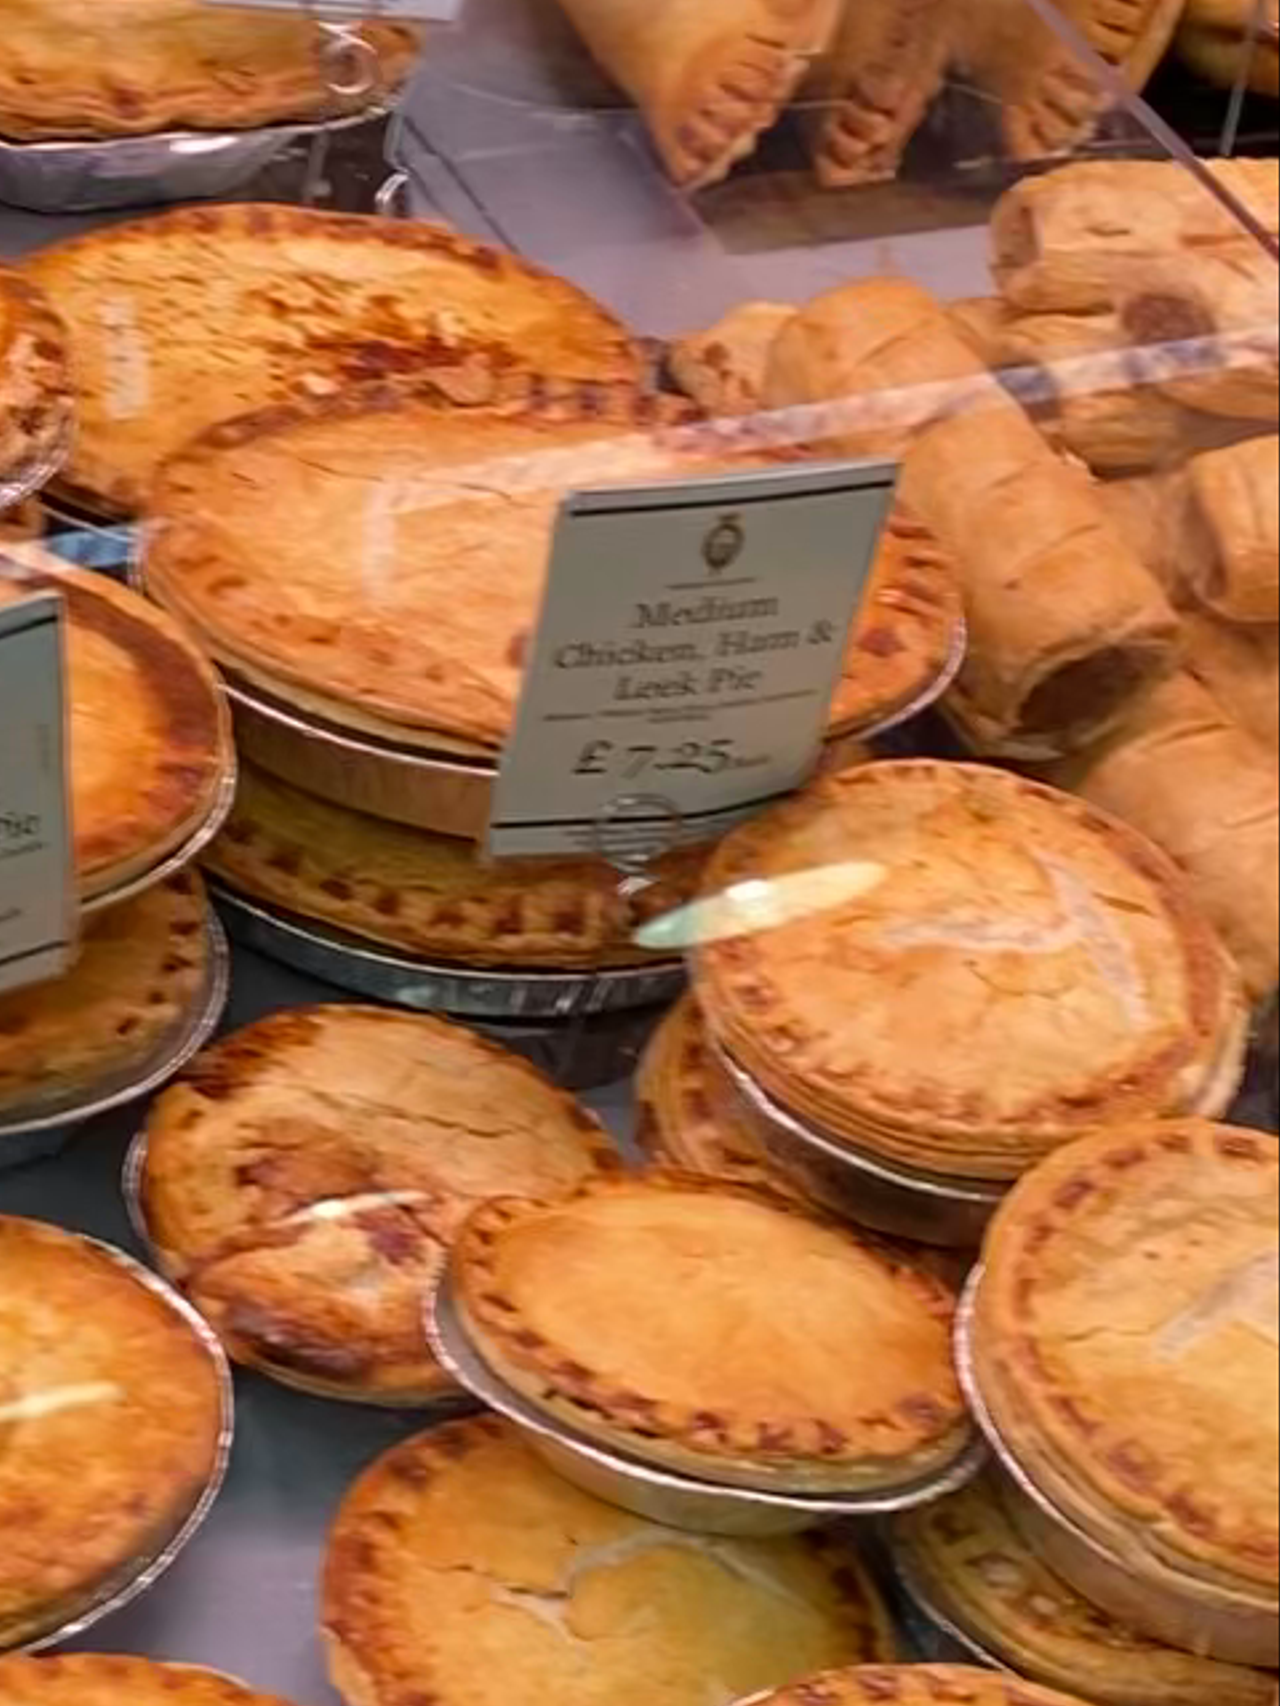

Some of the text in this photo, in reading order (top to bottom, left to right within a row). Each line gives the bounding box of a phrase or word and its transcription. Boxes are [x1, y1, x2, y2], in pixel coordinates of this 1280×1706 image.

[628, 595, 780, 629] Medium
[715, 629, 801, 657] Ham
[806, 618, 837, 646] &
[612, 665, 763, 701] Leek Pie
